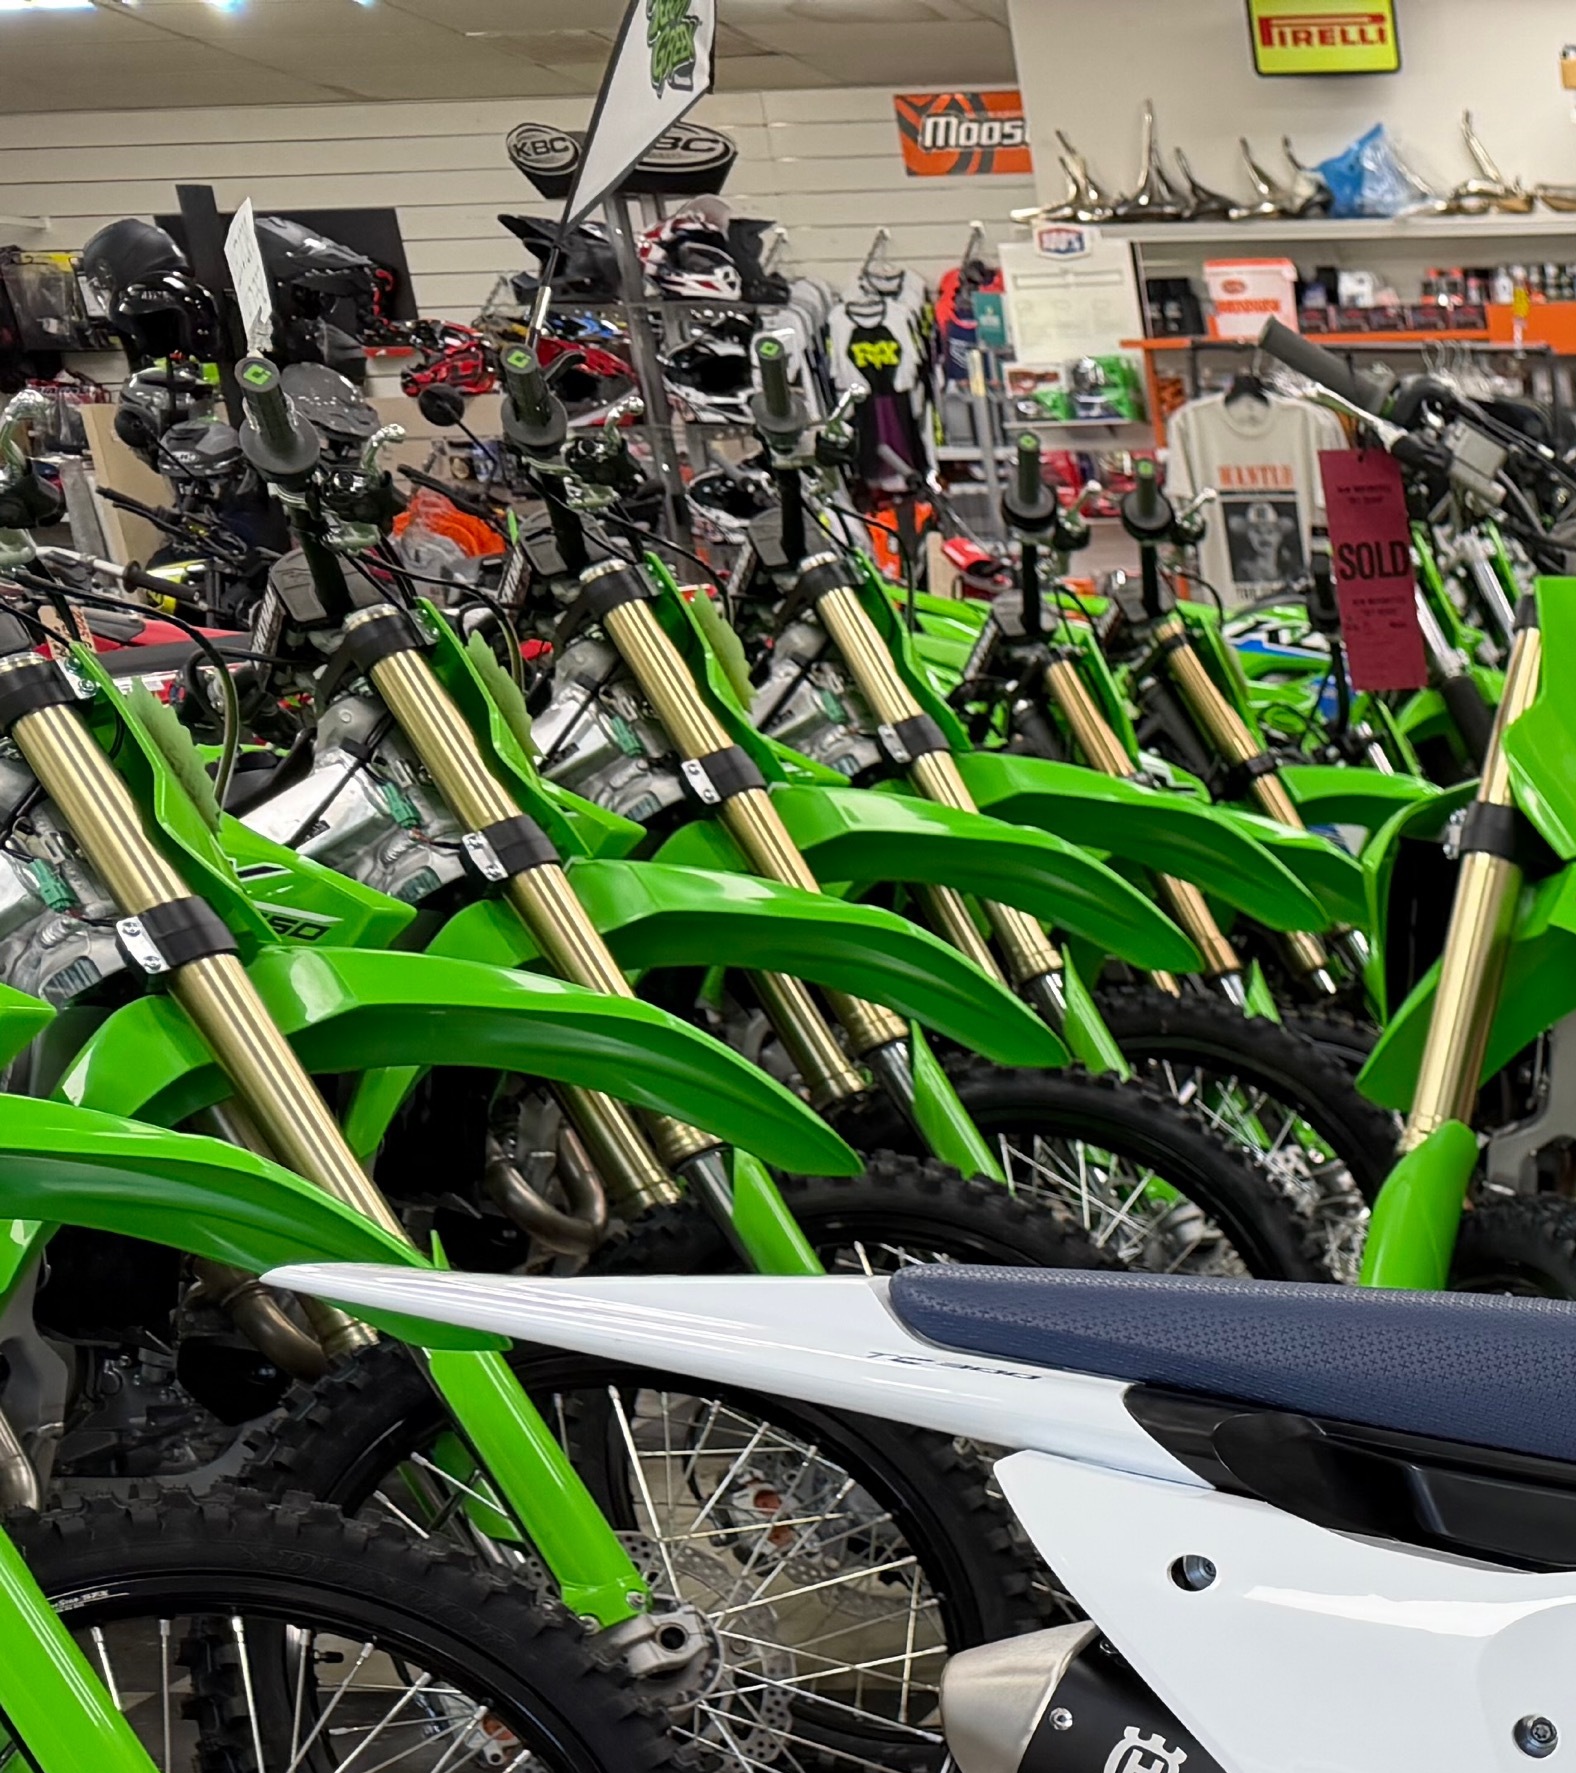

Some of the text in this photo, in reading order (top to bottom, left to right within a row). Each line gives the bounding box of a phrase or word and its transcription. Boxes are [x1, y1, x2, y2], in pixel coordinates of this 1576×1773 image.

[1258, 14, 1388, 48] PIRELLI
[513, 135, 570, 158] KBC
[651, 134, 721, 154] BC
[919, 112, 1032, 152] Moos
[1338, 539, 1411, 581] SOLD
